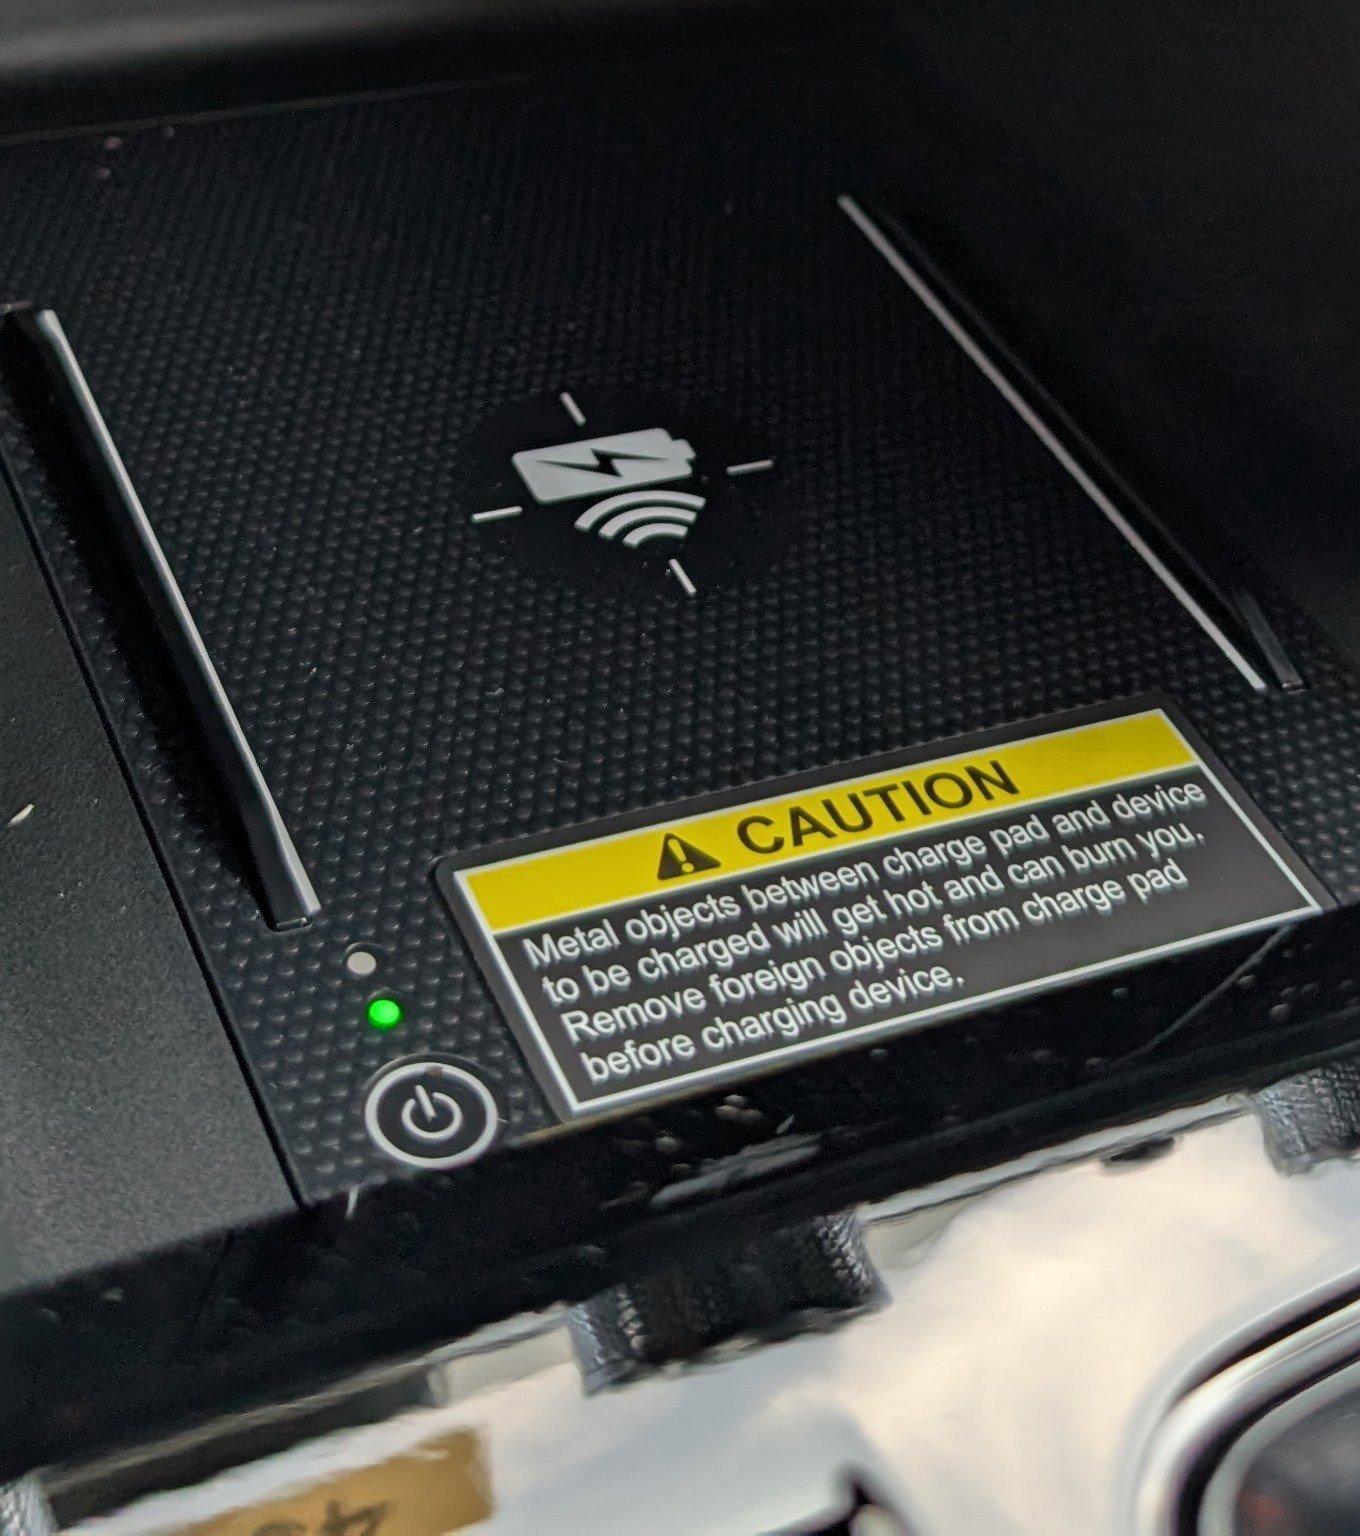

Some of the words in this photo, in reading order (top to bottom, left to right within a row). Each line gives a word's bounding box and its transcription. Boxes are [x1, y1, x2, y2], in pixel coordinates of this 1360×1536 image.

[523, 919, 620, 969] Metal
[625, 894, 741, 941] objects
[740, 861, 880, 912] between
[882, 833, 987, 877] charge
[990, 815, 1050, 858] pad
[1052, 799, 1112, 836] and
[1111, 783, 1207, 820] device
[737, 760, 1020, 854] CAUTION
[542, 976, 580, 1005] to
[582, 964, 632, 996] be
[637, 922, 771, 979] charged
[771, 908, 829, 946] will
[831, 894, 887, 940] get
[884, 880, 942, 917] hot
[943, 864, 1005, 902] and
[1007, 852, 1065, 888] can
[1061, 835, 1137, 870] burn
[1135, 822, 1205, 860] you.
[561, 986, 706, 1043] Remove
[709, 955, 826, 1005] foreign
[829, 922, 943, 971] objects
[943, 905, 1020, 944] from
[1022, 879, 1127, 923] charge
[1127, 858, 1188, 903] pad
[580, 1033, 696, 1084] before
[701, 993, 846, 1052] charging
[848, 965, 965, 1012] device.
